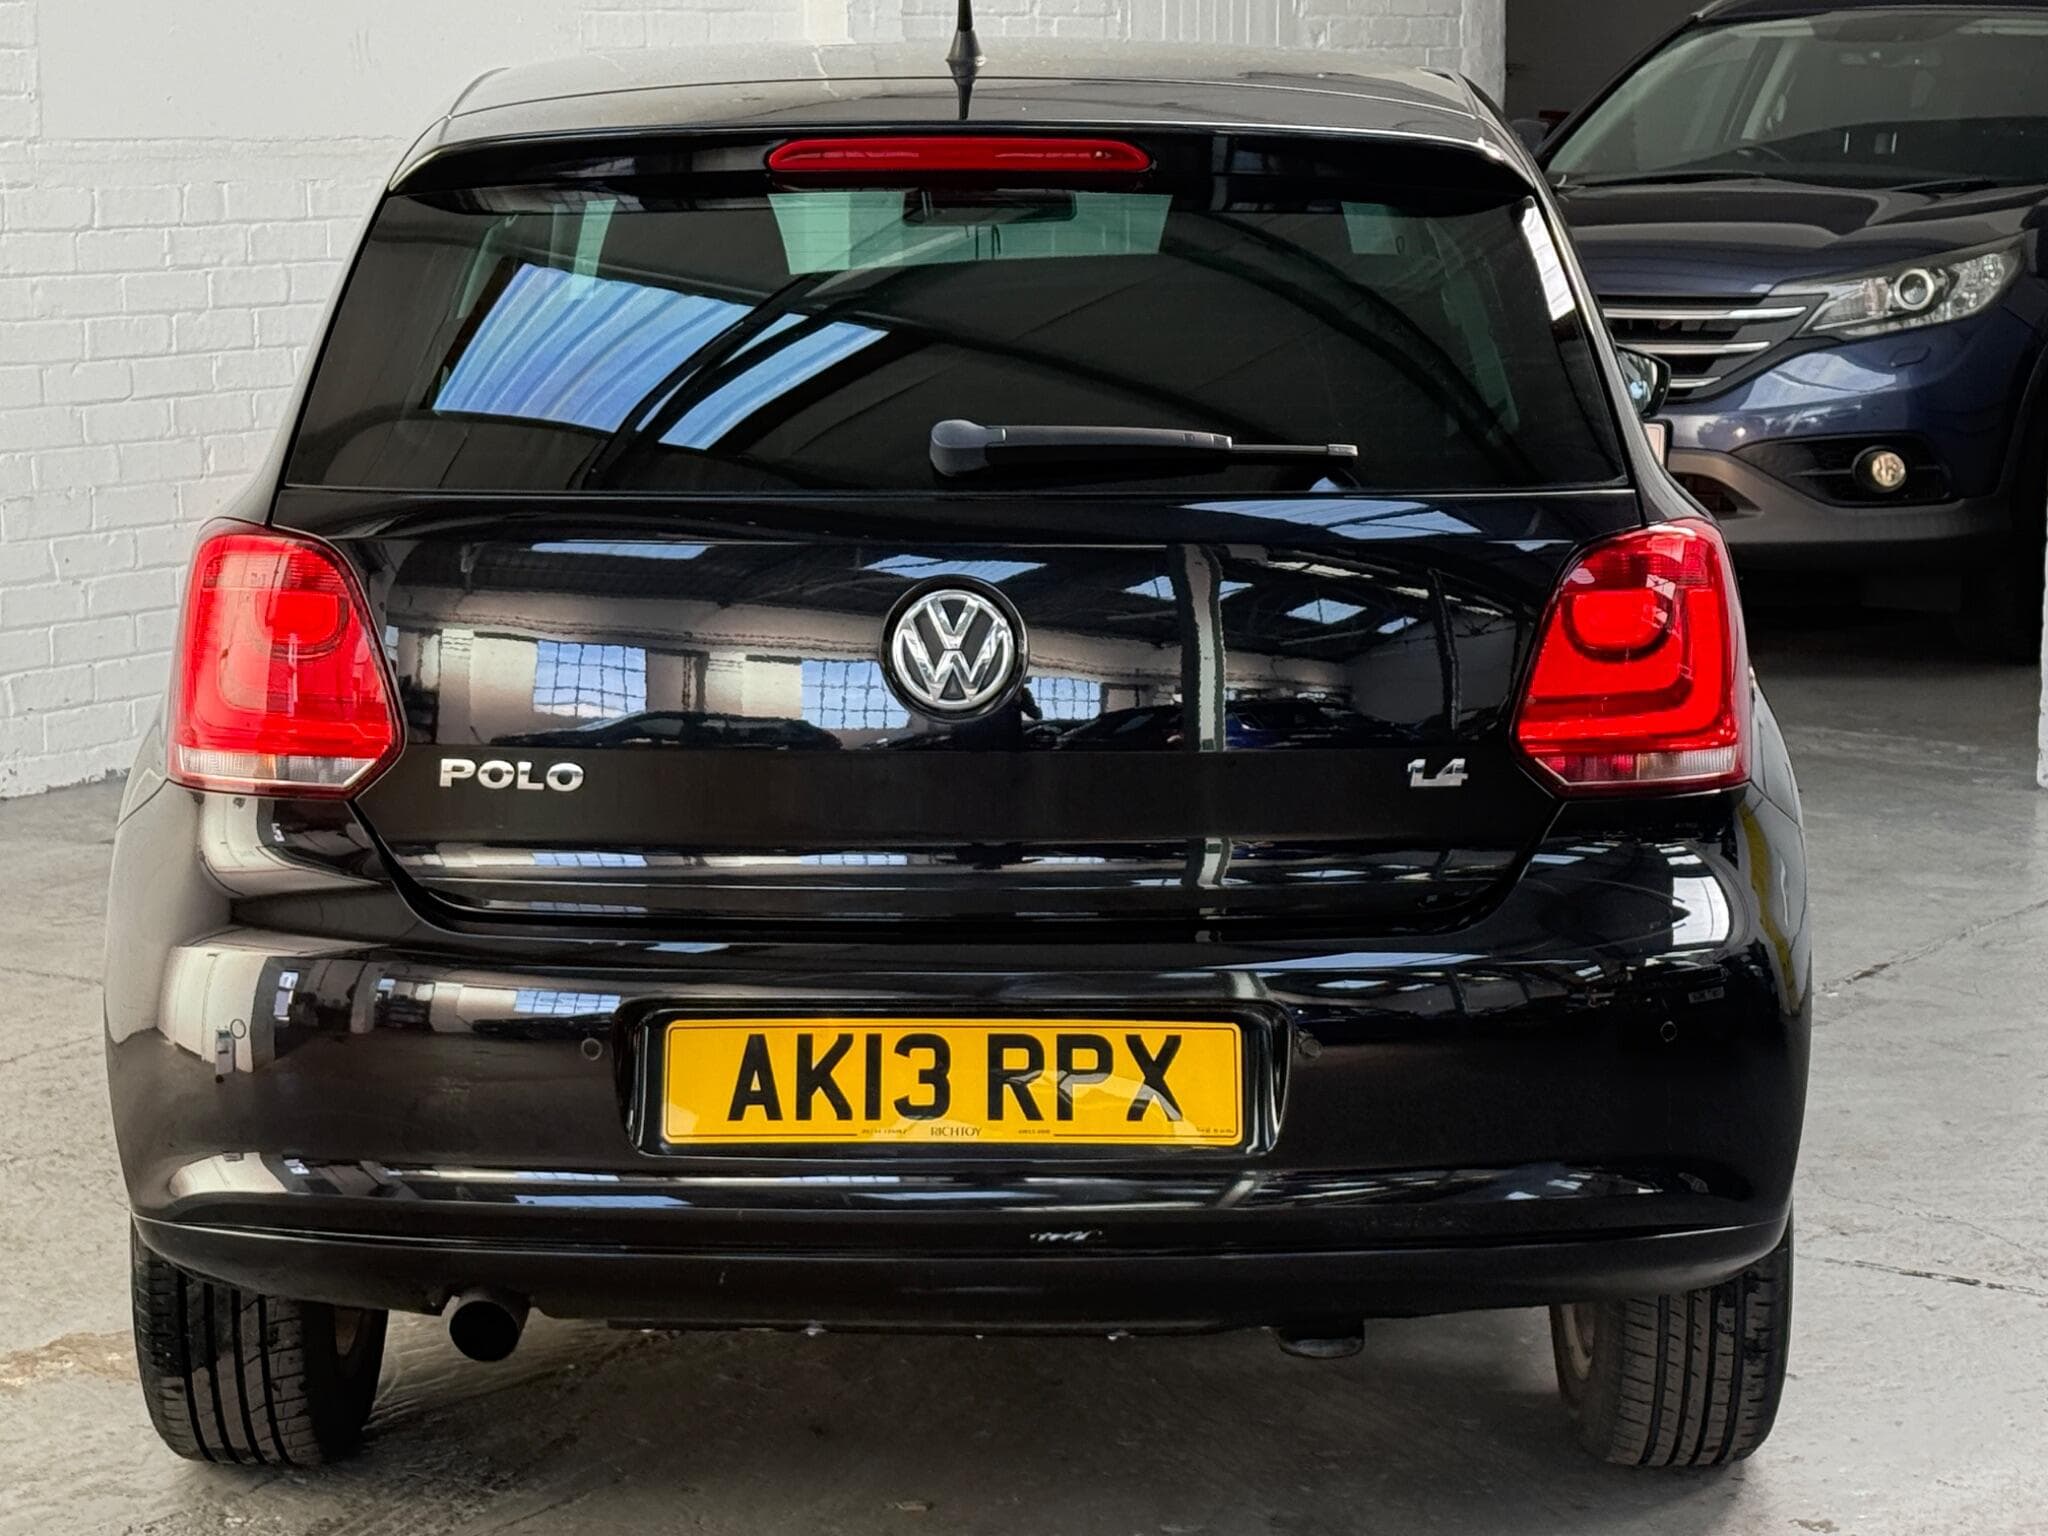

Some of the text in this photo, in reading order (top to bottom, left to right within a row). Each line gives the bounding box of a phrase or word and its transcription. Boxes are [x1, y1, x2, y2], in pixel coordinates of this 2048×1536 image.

[439, 758, 584, 792] POLO
[1407, 758, 1469, 787] 1.4
[727, 1032, 1183, 1122] AK13 RPX
